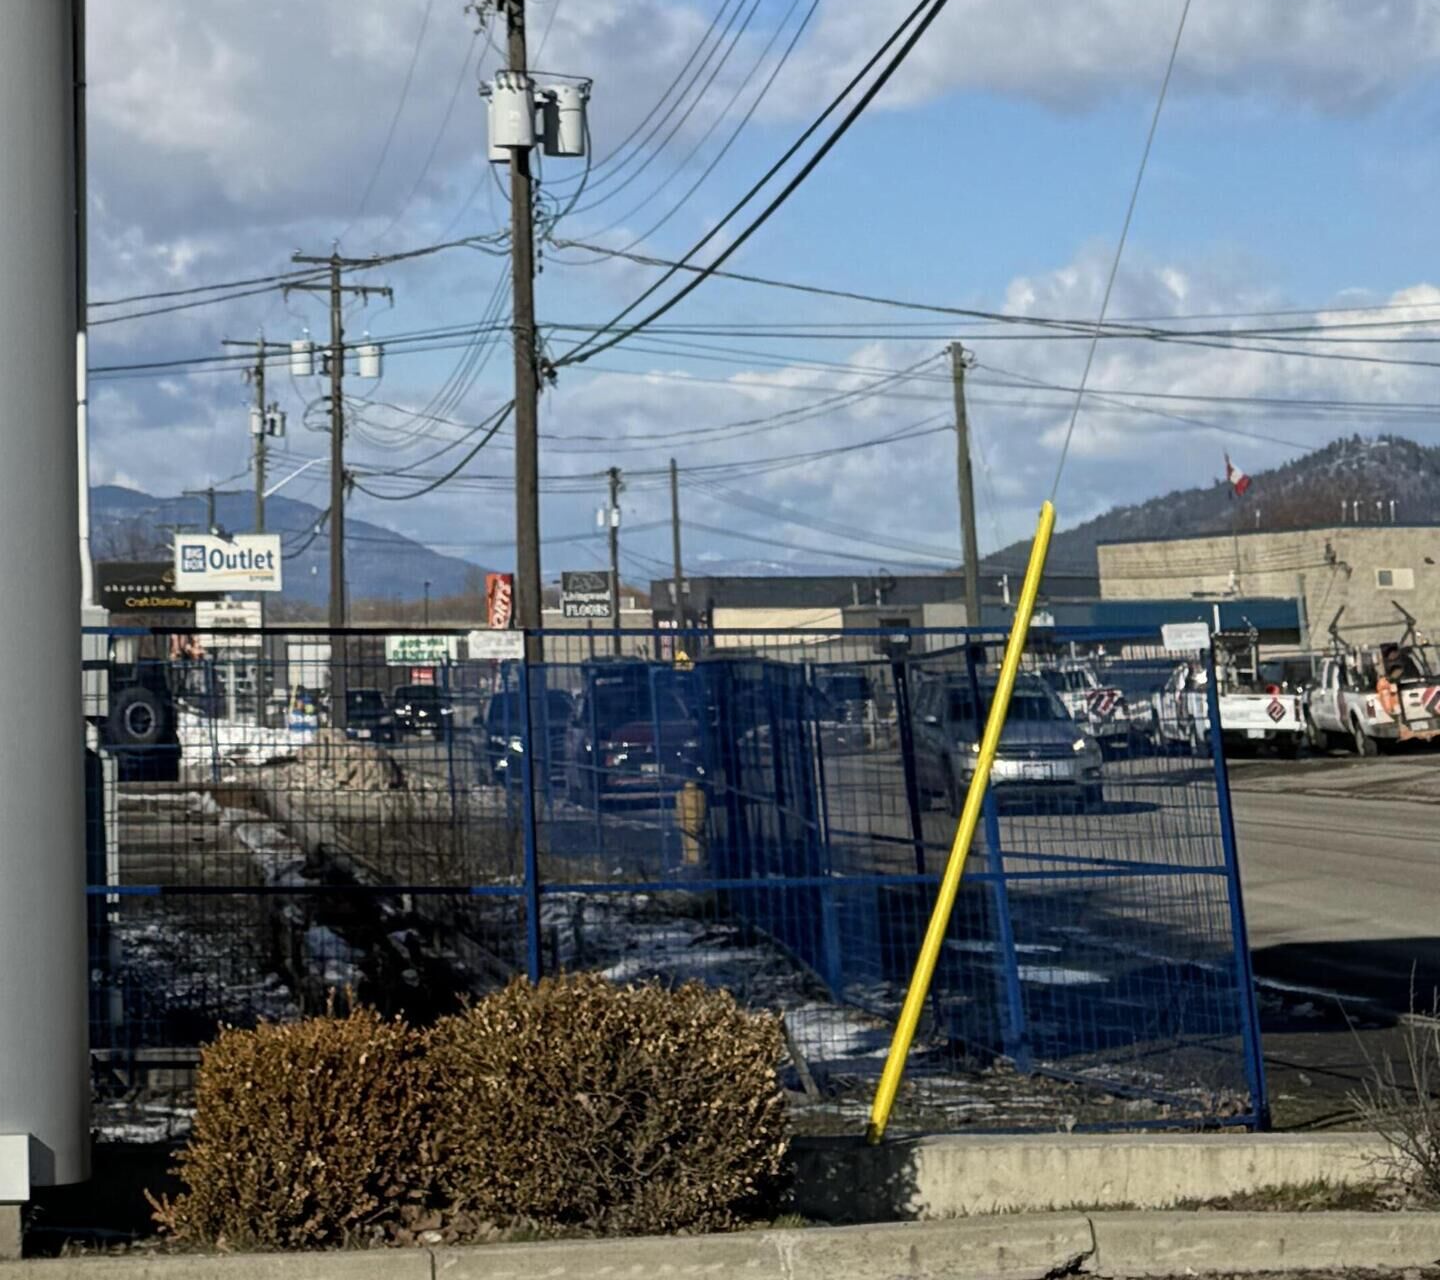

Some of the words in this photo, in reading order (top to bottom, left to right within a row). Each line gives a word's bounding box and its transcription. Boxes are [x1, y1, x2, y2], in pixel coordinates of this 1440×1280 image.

[209, 548, 275, 571] Outlet
[492, 580, 512, 629] ORTS
[565, 603, 610, 617] FLOORS
